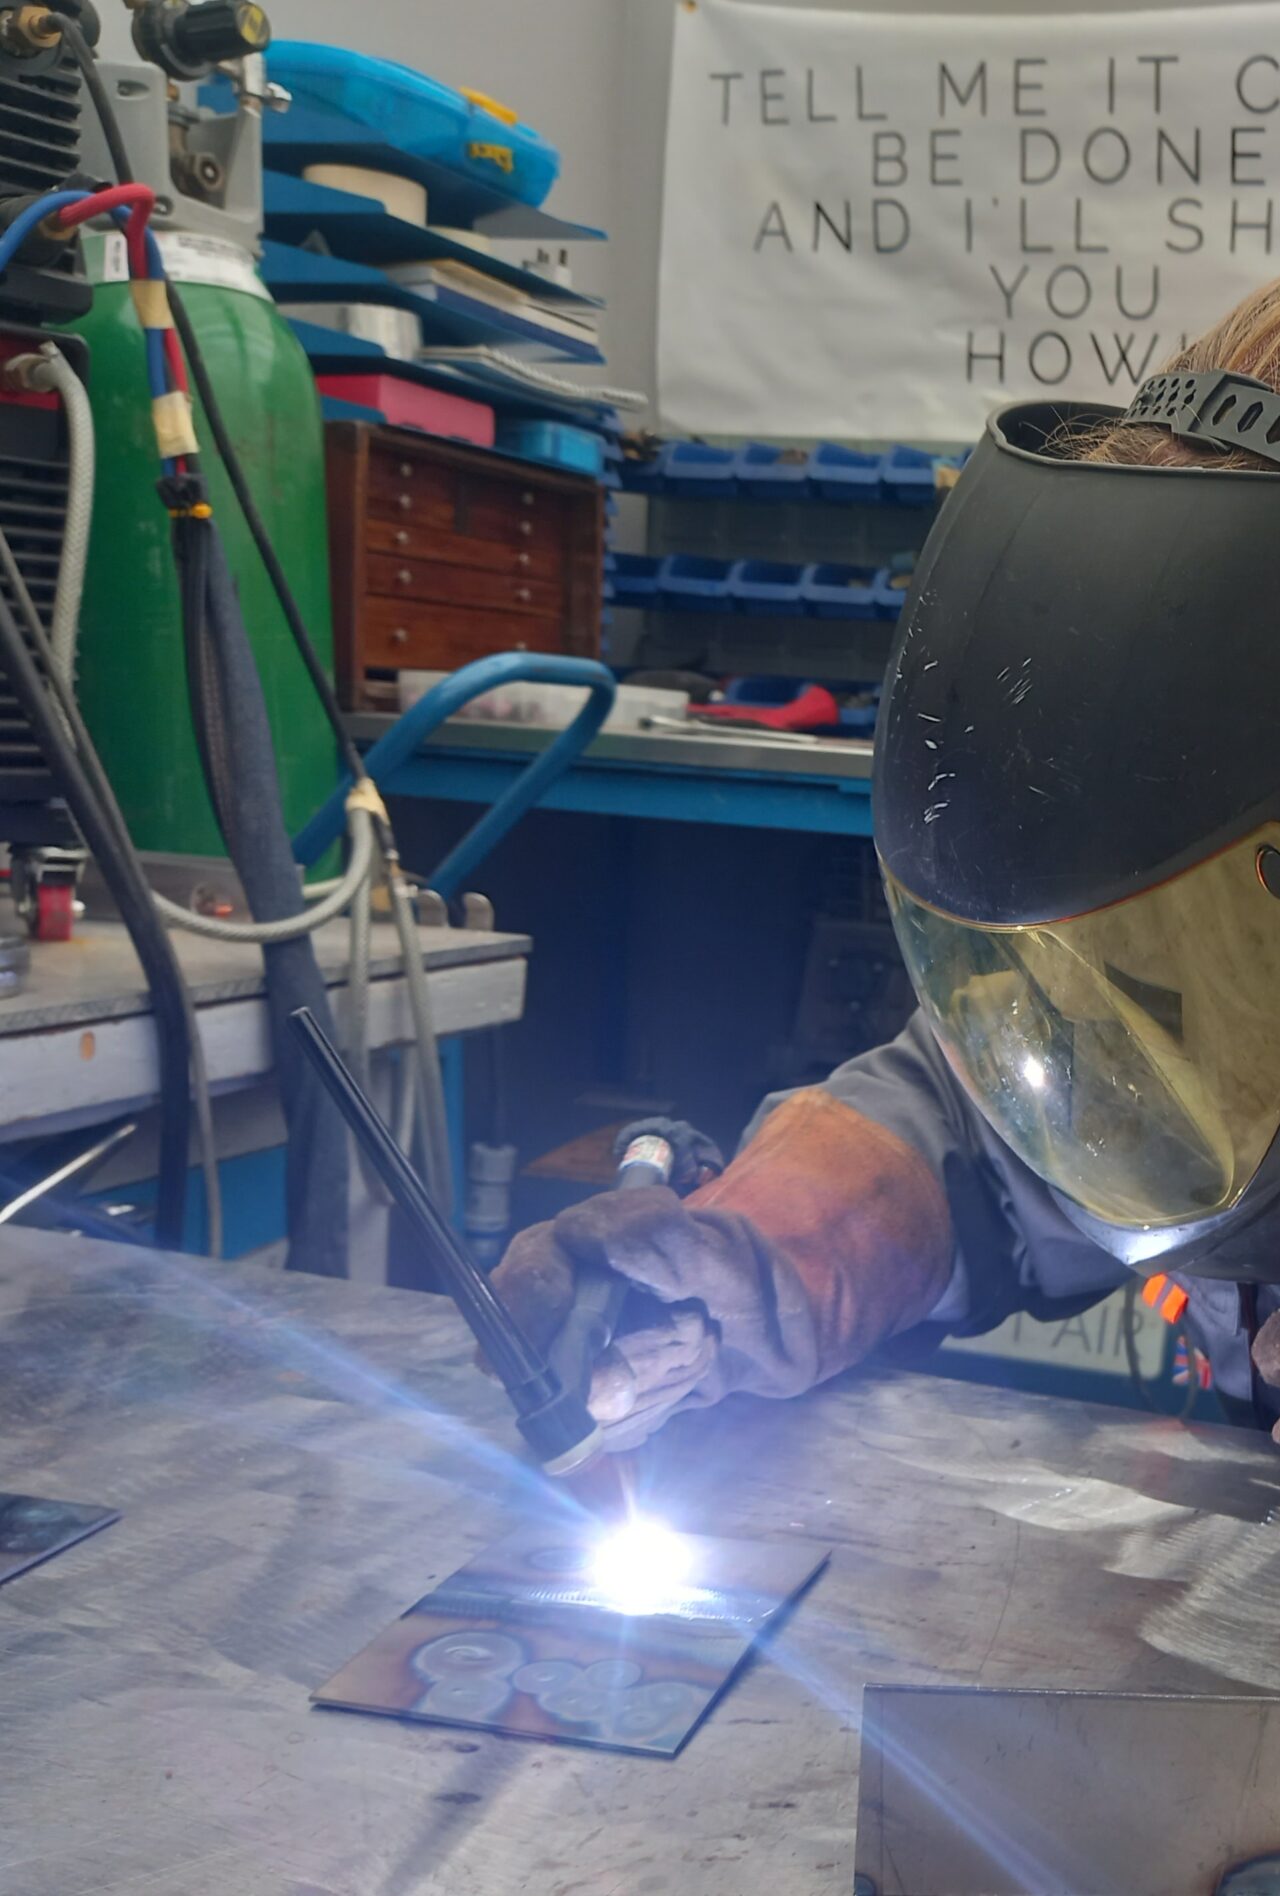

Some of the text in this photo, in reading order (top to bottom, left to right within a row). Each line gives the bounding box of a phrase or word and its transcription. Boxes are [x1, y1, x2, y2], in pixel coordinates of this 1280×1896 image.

[709, 64, 888, 126] TELL
[937, 57, 1048, 118] ME
[1107, 55, 1180, 116] IT
[871, 129, 963, 187] BE
[753, 199, 911, 254] AND
[964, 198, 1110, 254] I'LL
[989, 263, 1161, 321] YOU
